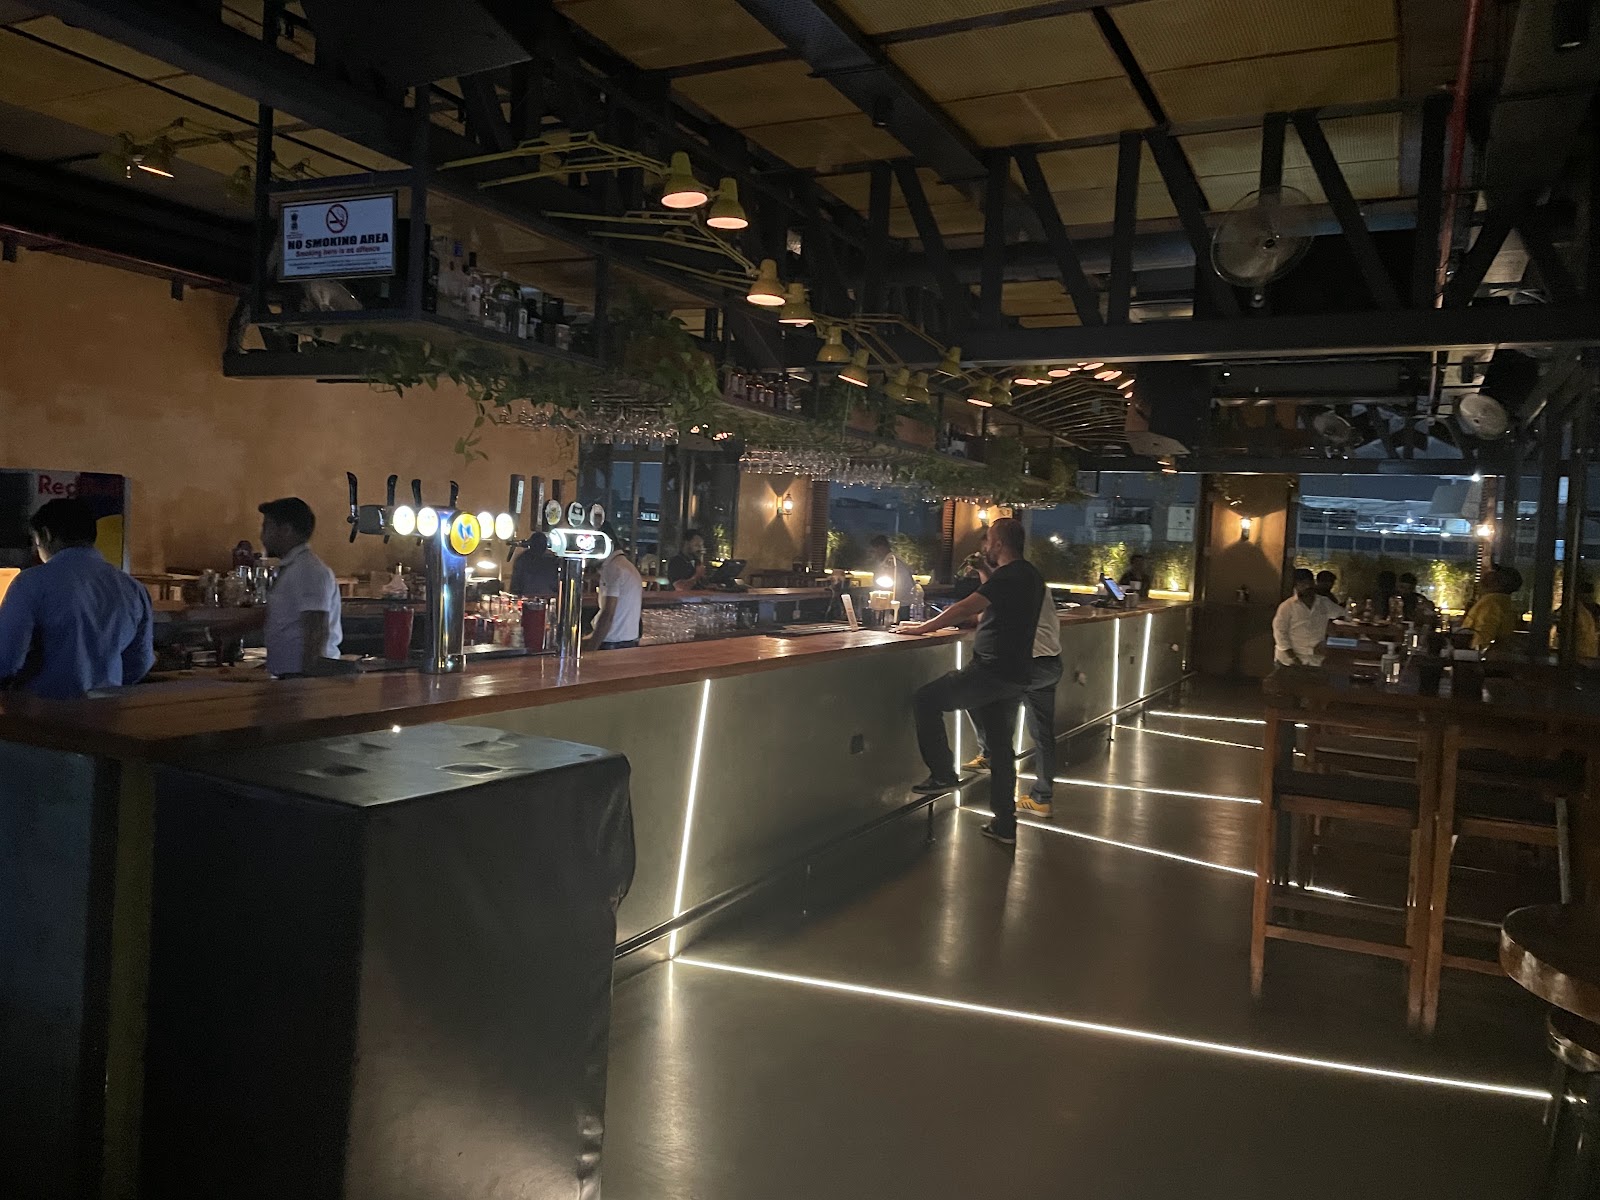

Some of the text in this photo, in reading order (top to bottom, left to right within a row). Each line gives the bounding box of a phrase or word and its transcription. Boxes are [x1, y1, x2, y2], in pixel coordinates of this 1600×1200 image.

[288, 240, 303, 250] NO
[305, 235, 357, 249] SMOKING
[360, 233, 389, 244] AREA
[296, 249, 322, 258] Smoking
